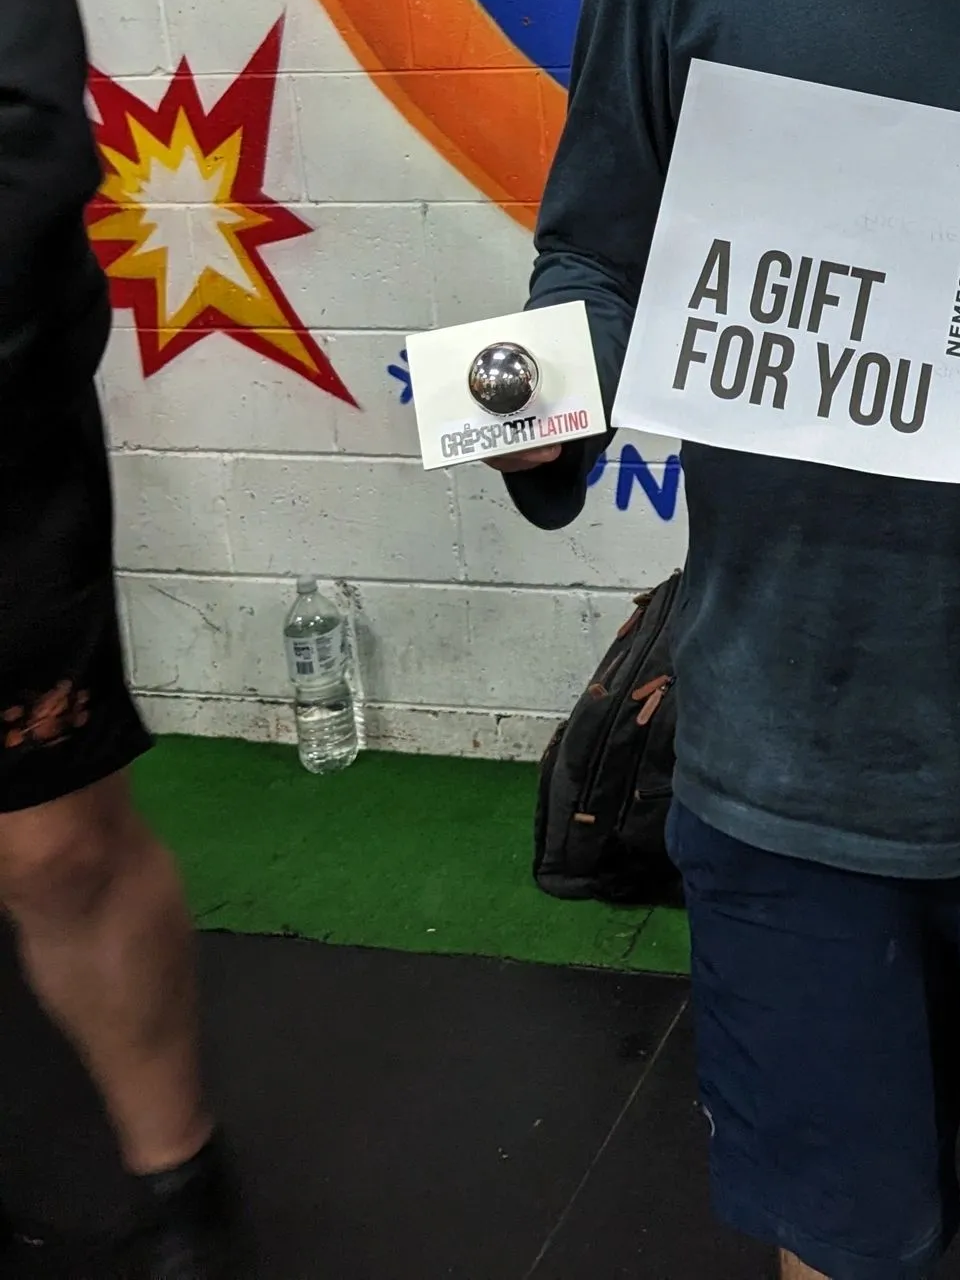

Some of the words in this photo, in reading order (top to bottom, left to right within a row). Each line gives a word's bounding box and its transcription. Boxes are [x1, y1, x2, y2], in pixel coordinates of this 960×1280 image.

[687, 238, 732, 316] A
[749, 249, 887, 342] GIFT
[537, 409, 590, 439] LATINO
[671, 316, 796, 410] FOR
[816, 341, 934, 434] YOU
